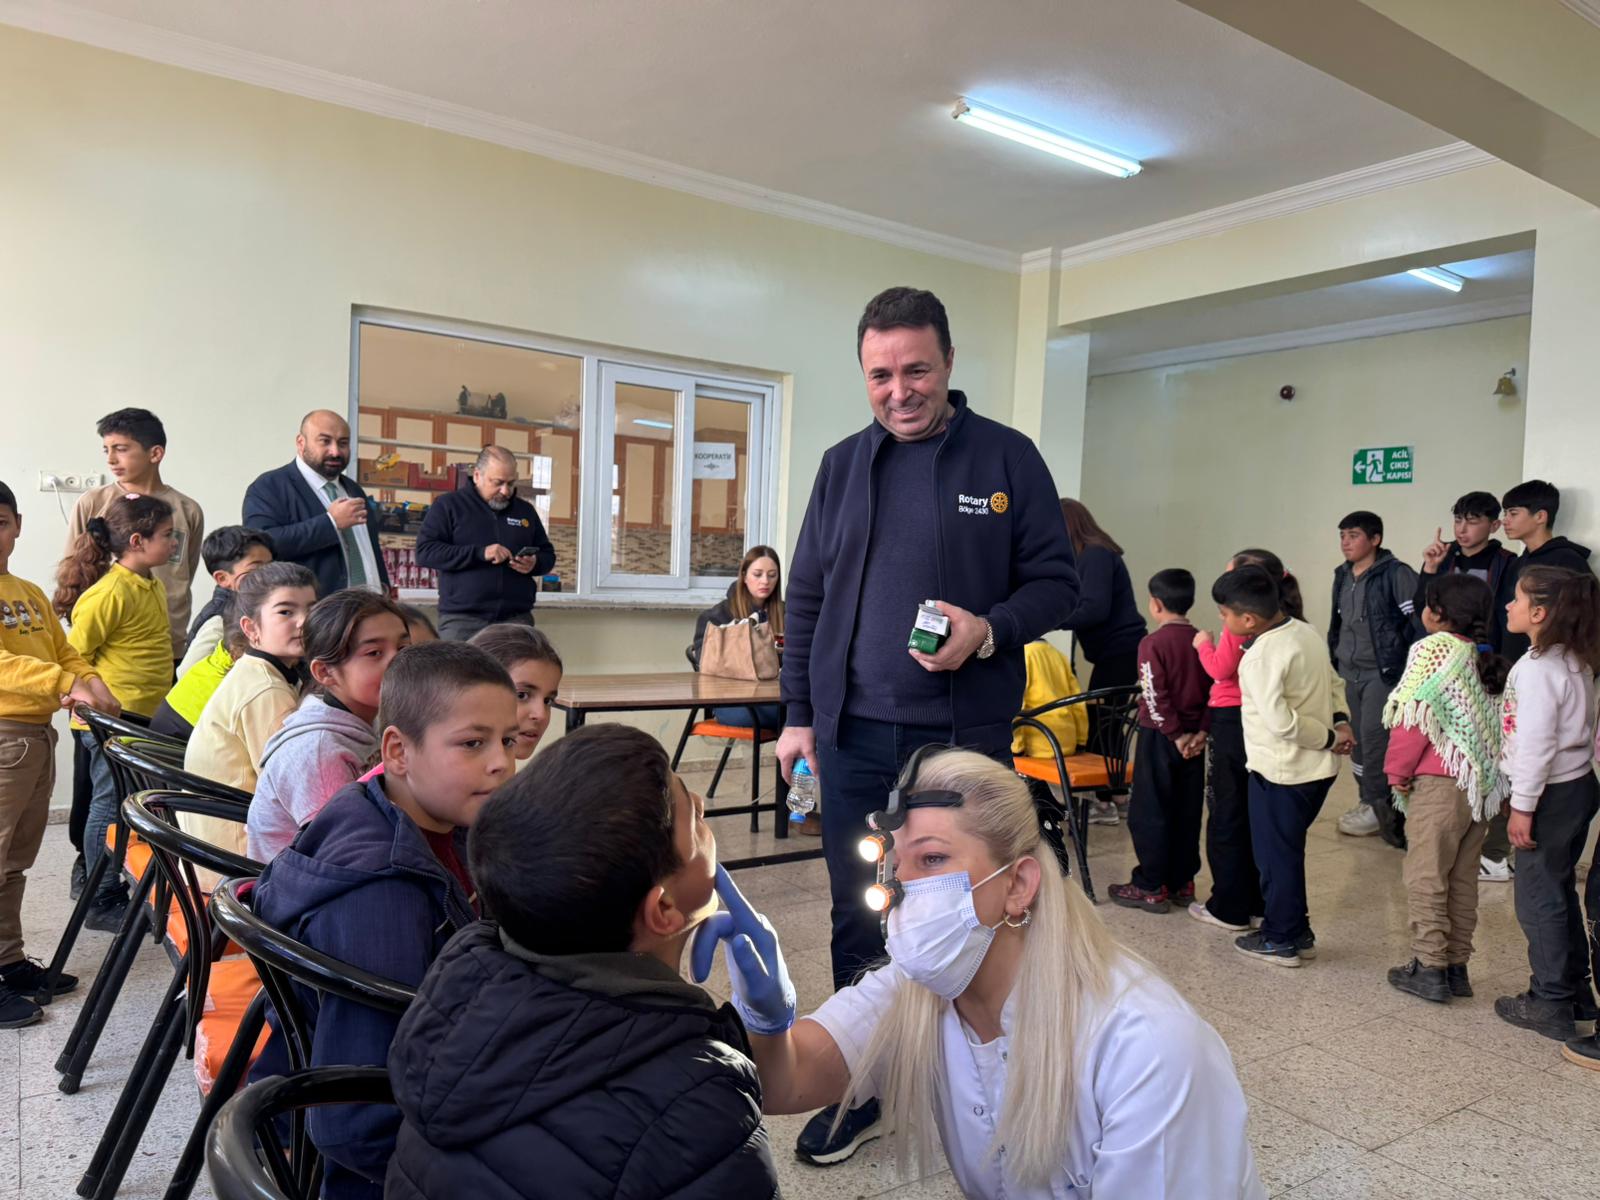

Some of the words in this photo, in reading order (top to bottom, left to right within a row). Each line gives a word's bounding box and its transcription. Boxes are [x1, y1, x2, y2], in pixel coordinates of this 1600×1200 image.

[1392, 449, 1408, 459] ACİL
[1386, 471, 1412, 480] KAPISI
[959, 494, 988, 507] Rotary
